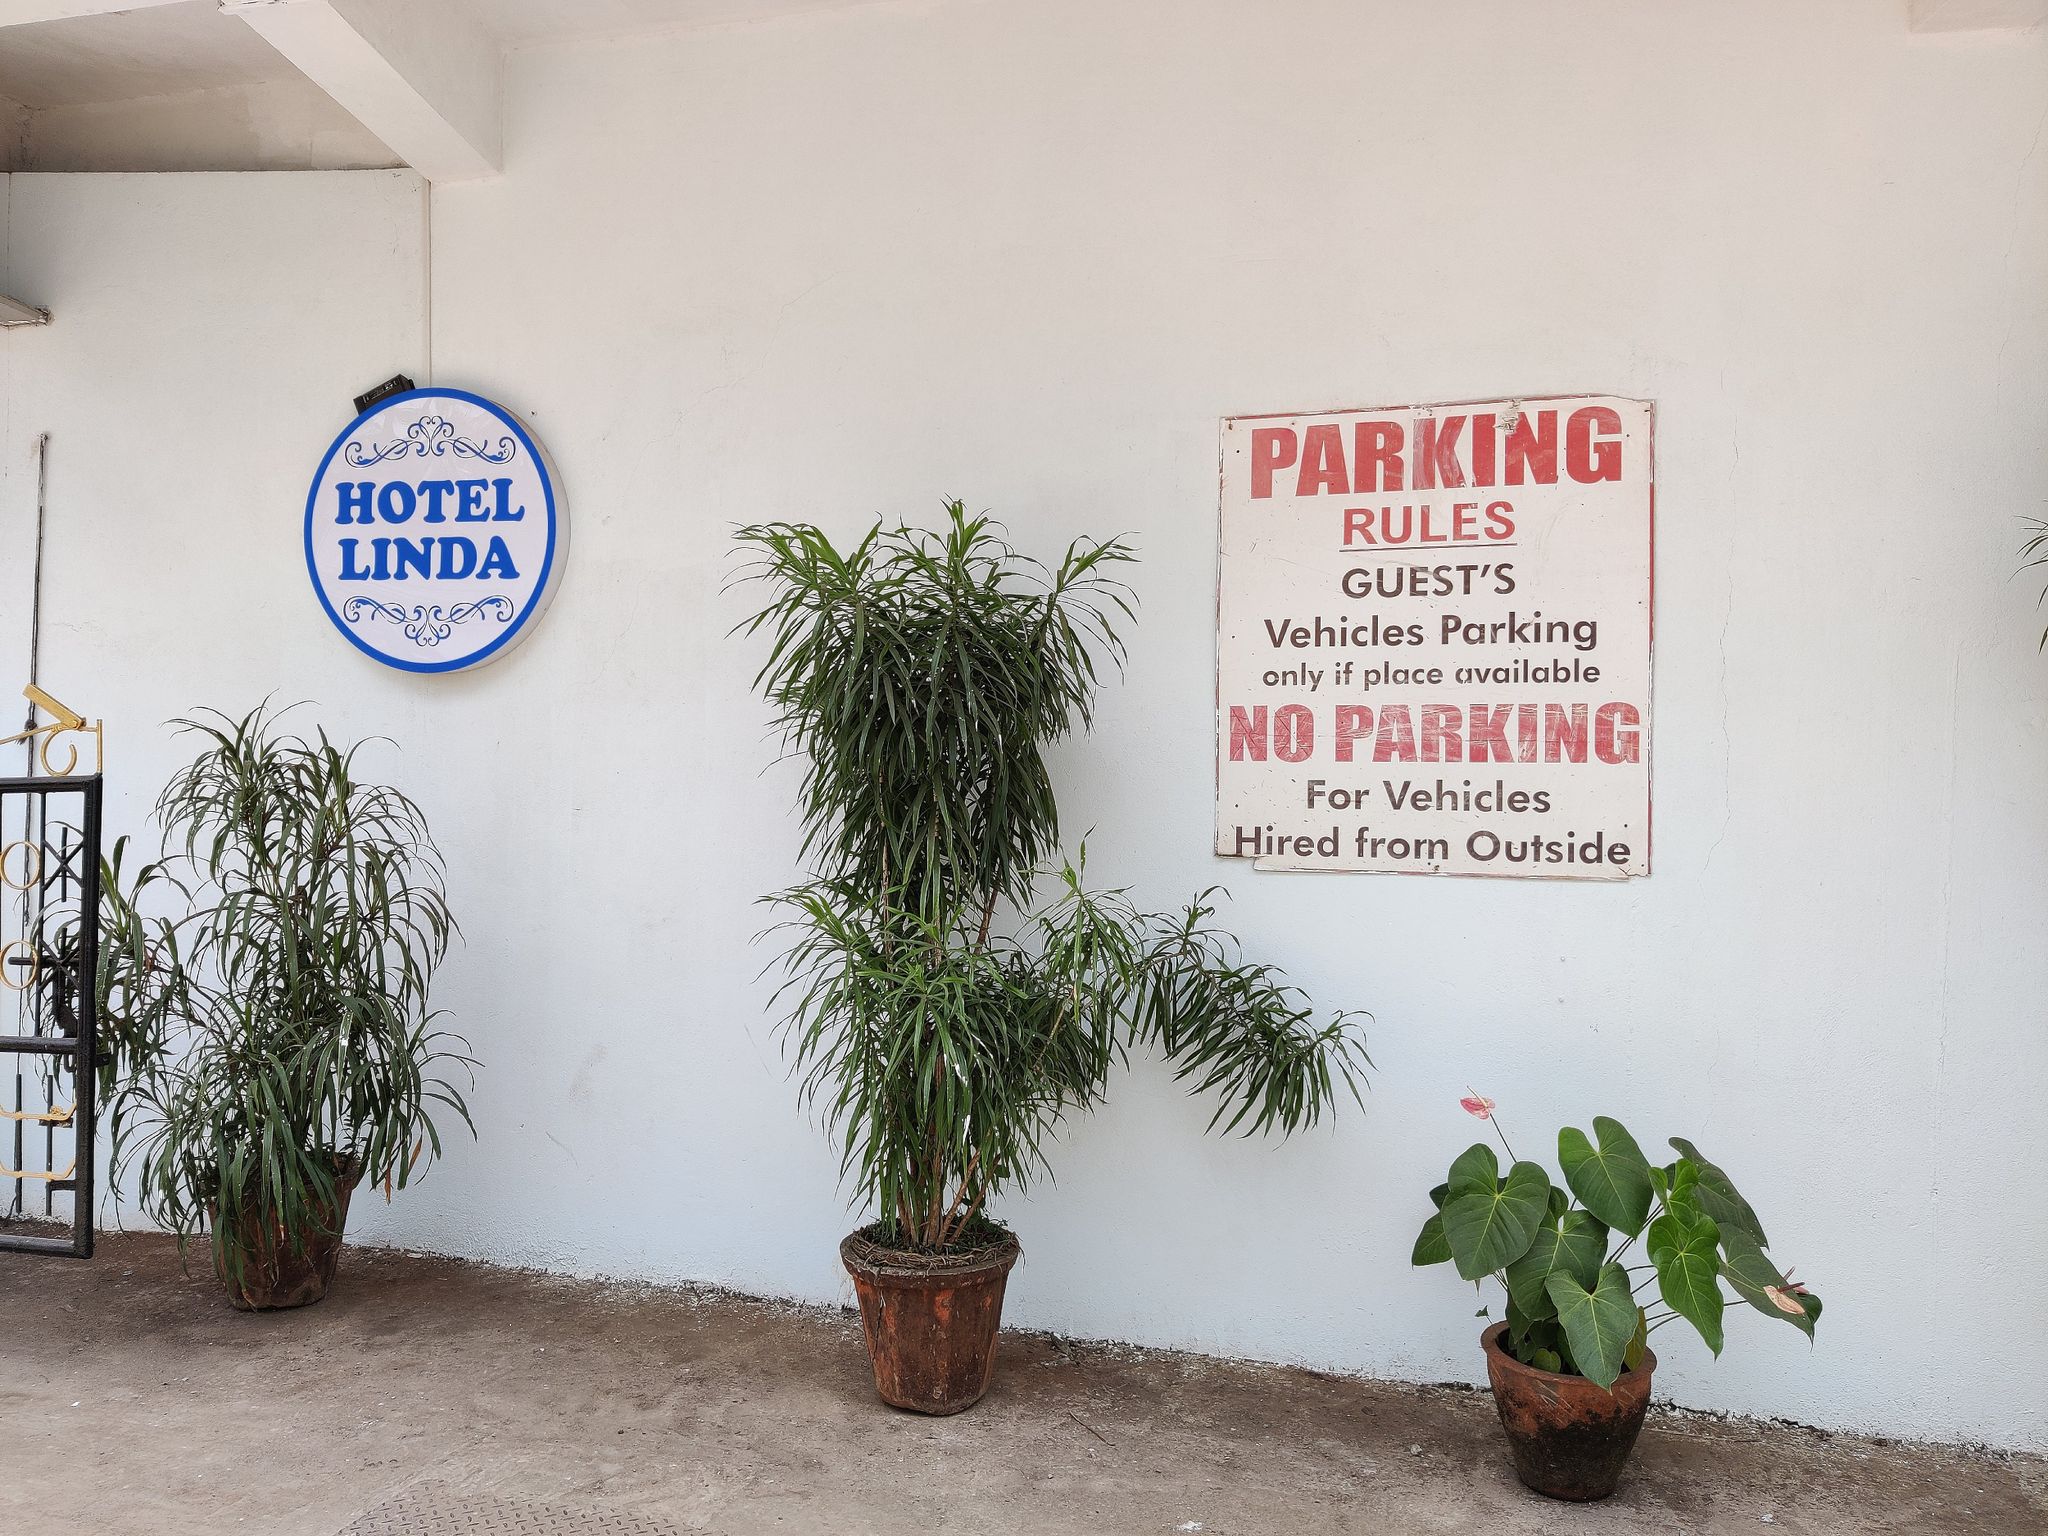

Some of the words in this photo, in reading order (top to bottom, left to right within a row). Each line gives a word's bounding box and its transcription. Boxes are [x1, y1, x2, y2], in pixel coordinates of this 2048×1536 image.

[1250, 406, 1623, 499] PARKING
[335, 478, 526, 525] HOTEL
[1343, 501, 1516, 545] RULES
[338, 535, 521, 581] LINDA
[1341, 563, 1516, 599] GUEST'S
[1264, 615, 1424, 648] Vehicles
[1441, 611, 1598, 651] Parking
[1262, 663, 1324, 692] only
[1335, 661, 1353, 686] if
[1364, 660, 1443, 692] place
[1455, 658, 1601, 685] available
[1229, 703, 1314, 763] NO
[1334, 701, 1641, 765] PARKING
[1306, 779, 1370, 811] For
[1382, 779, 1551, 814] Vehicles
[1235, 825, 1340, 858] Hired
[1355, 826, 1449, 860] from
[1466, 829, 1631, 865] Outside
